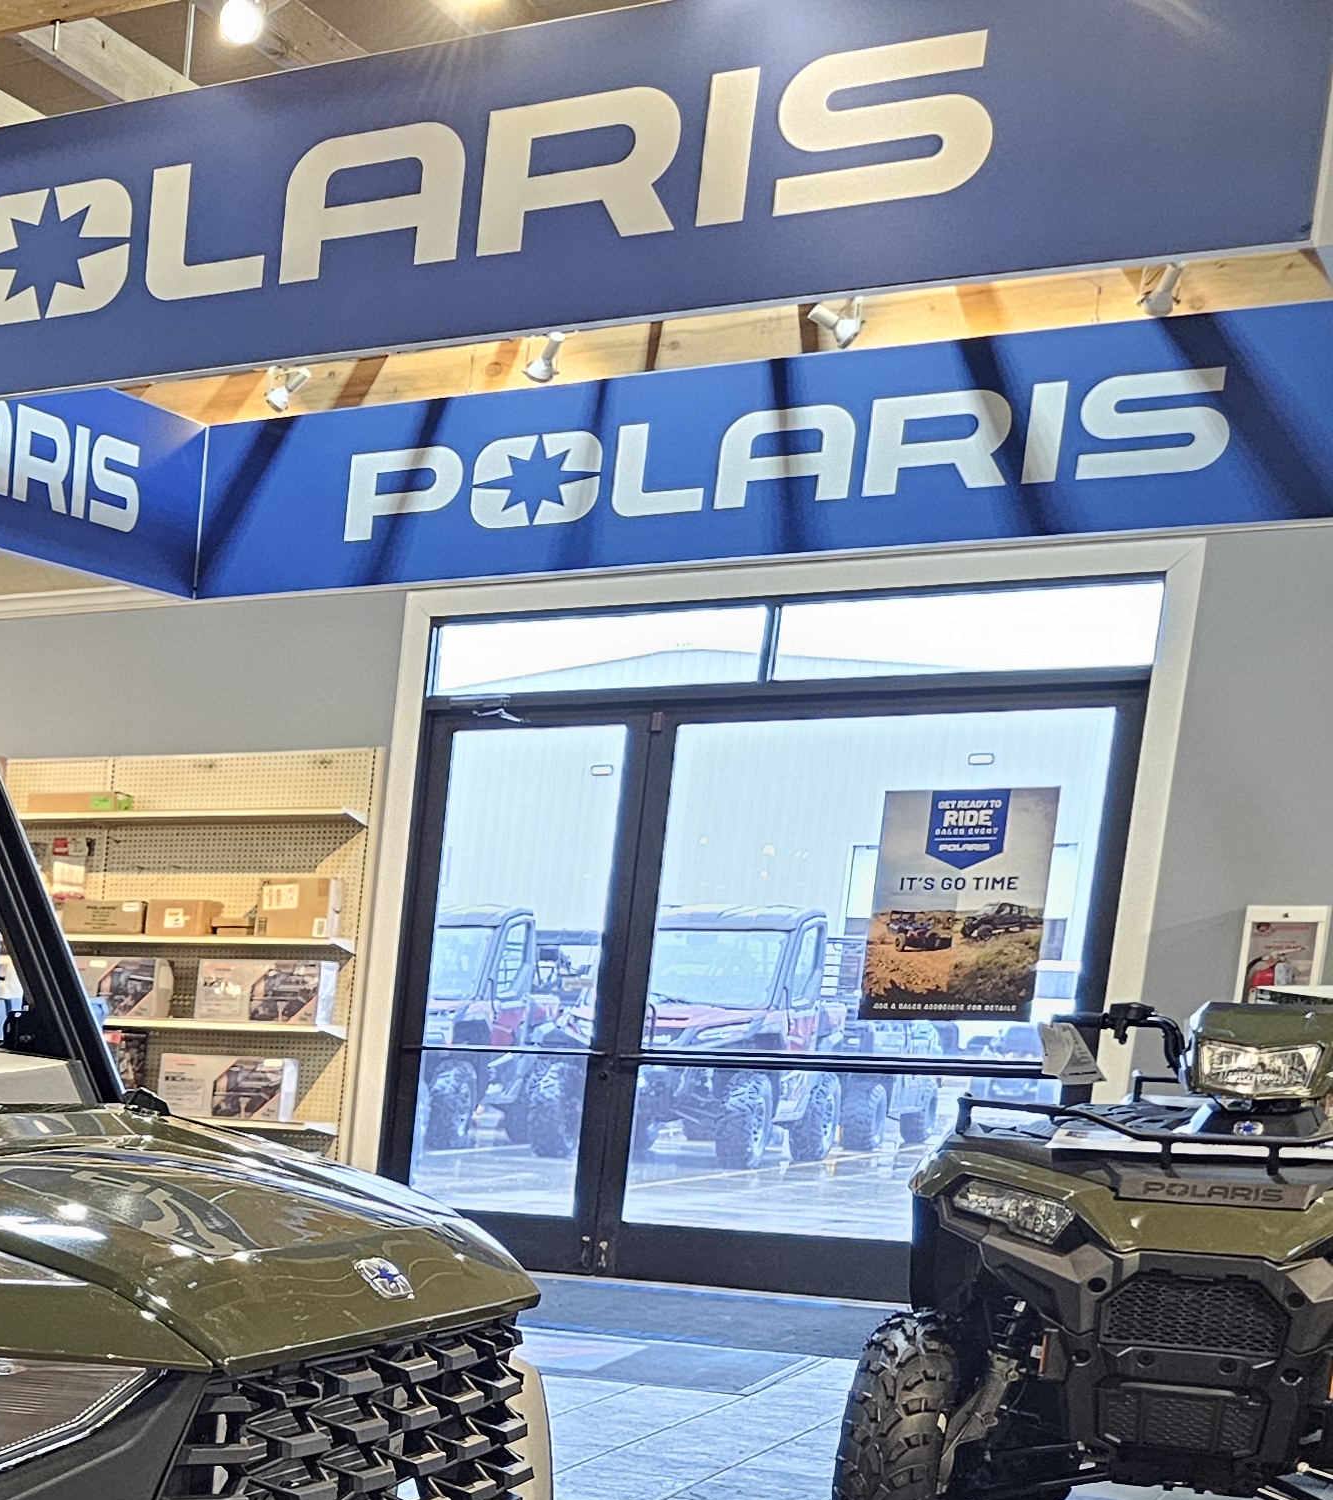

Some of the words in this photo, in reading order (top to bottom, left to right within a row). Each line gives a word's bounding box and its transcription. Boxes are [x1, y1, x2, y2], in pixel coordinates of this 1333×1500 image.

[343, 366, 1229, 543] POLARIS
[989, 799, 1003, 808] TO
[942, 809, 994, 828] RIDE
[938, 843, 991, 852] POLARIS
[899, 877, 935, 891] IT'S
[940, 877, 966, 890] GO
[972, 876, 1019, 890] TIME
[1142, 1181, 1284, 1203] POLARIS
